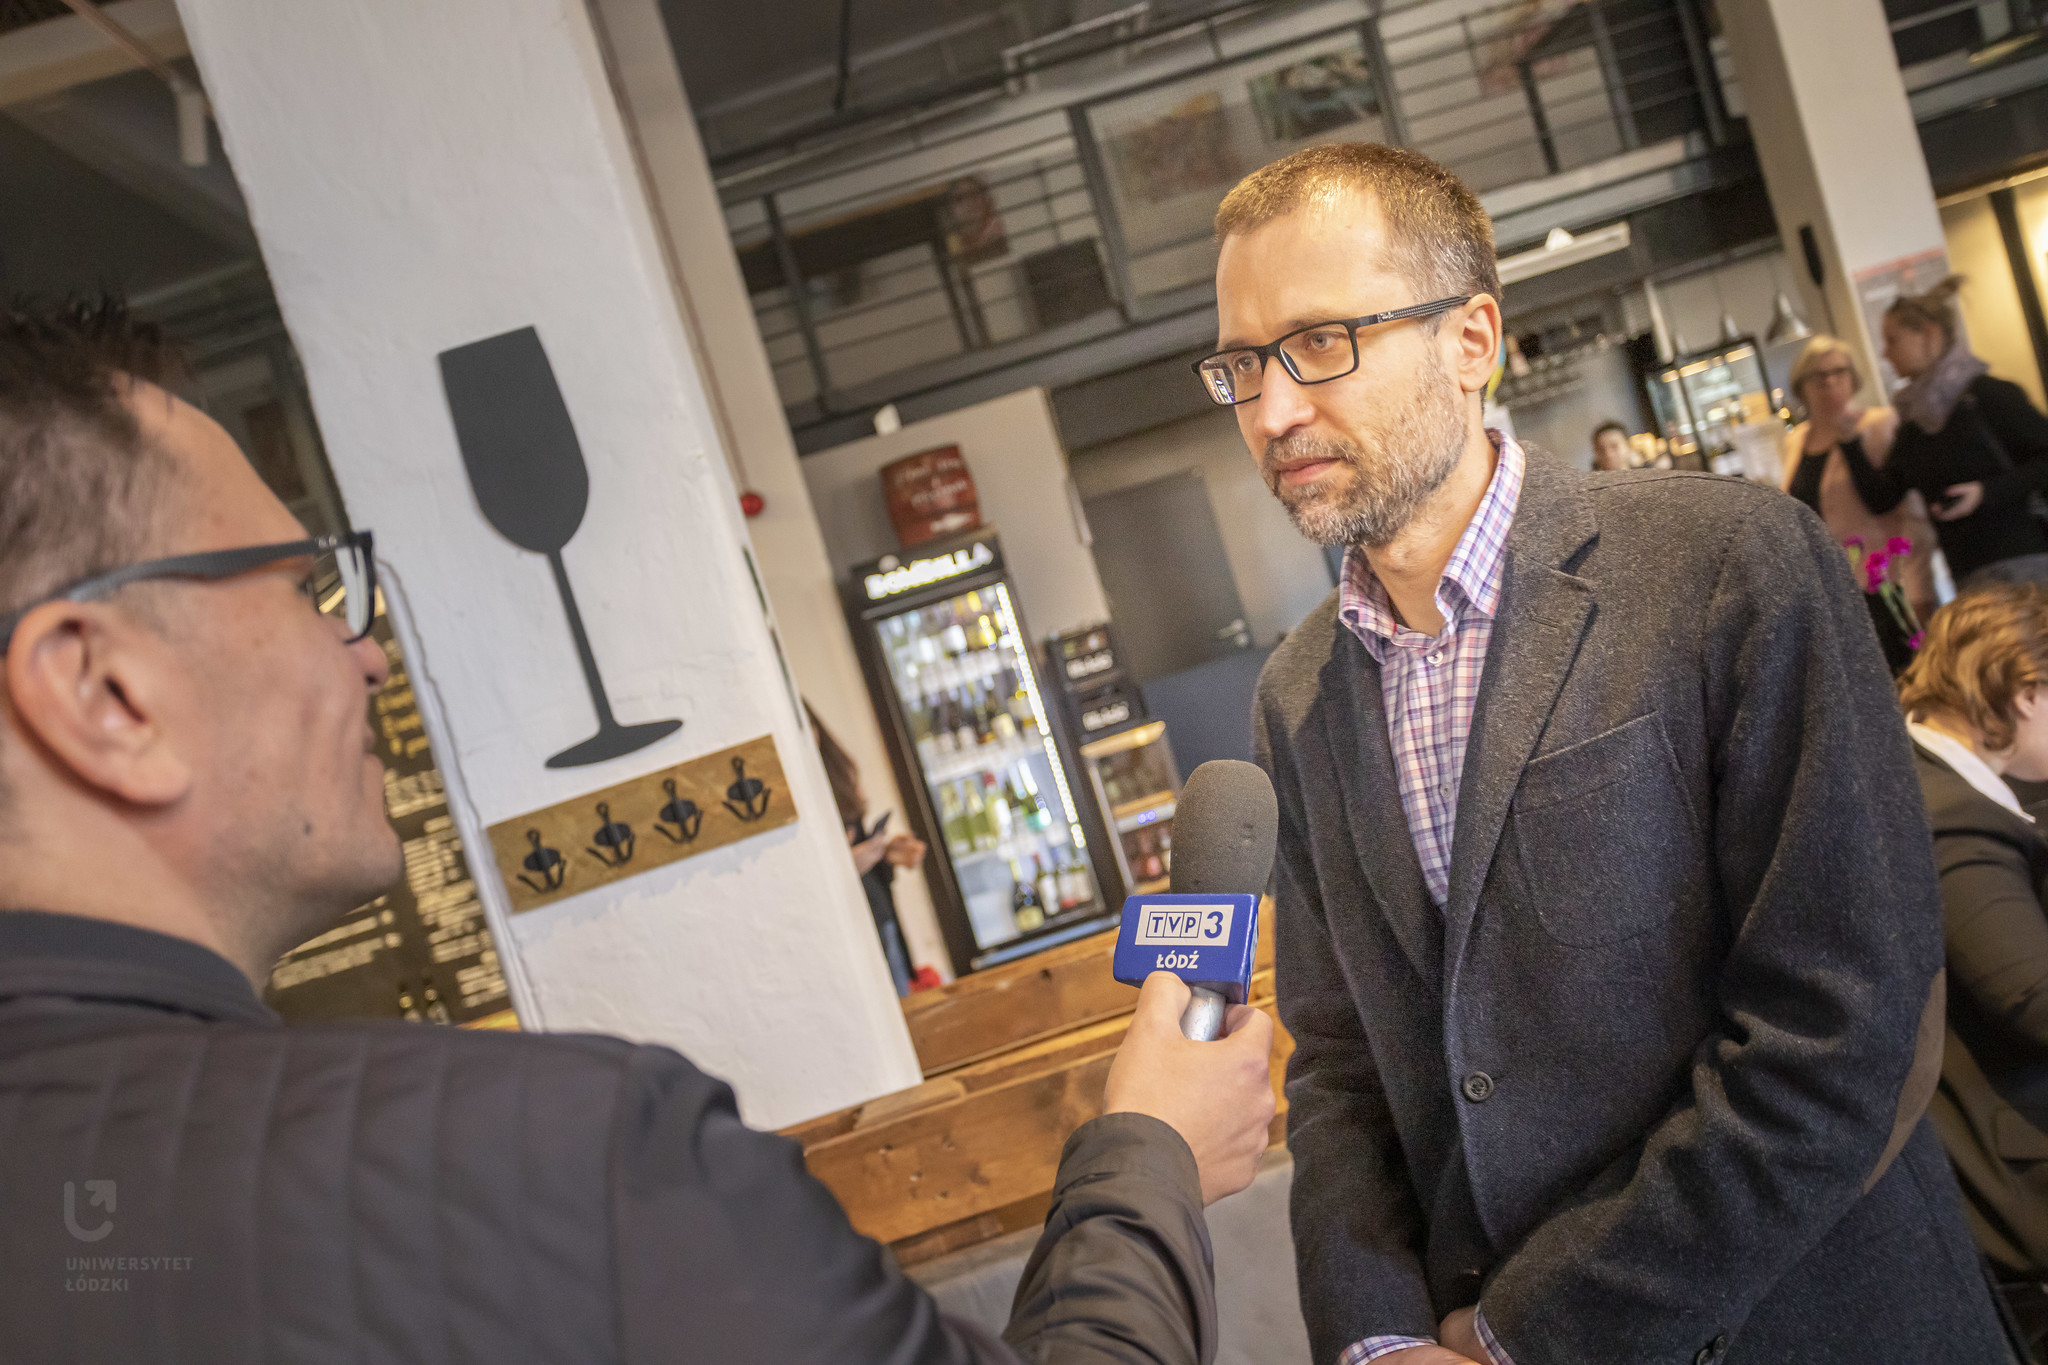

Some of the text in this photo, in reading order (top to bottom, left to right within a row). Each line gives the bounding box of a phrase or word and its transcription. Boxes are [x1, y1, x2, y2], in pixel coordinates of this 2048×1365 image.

[1152, 911, 1224, 939] TVP 3
[1156, 950, 1200, 969] ŁÓDŹ
